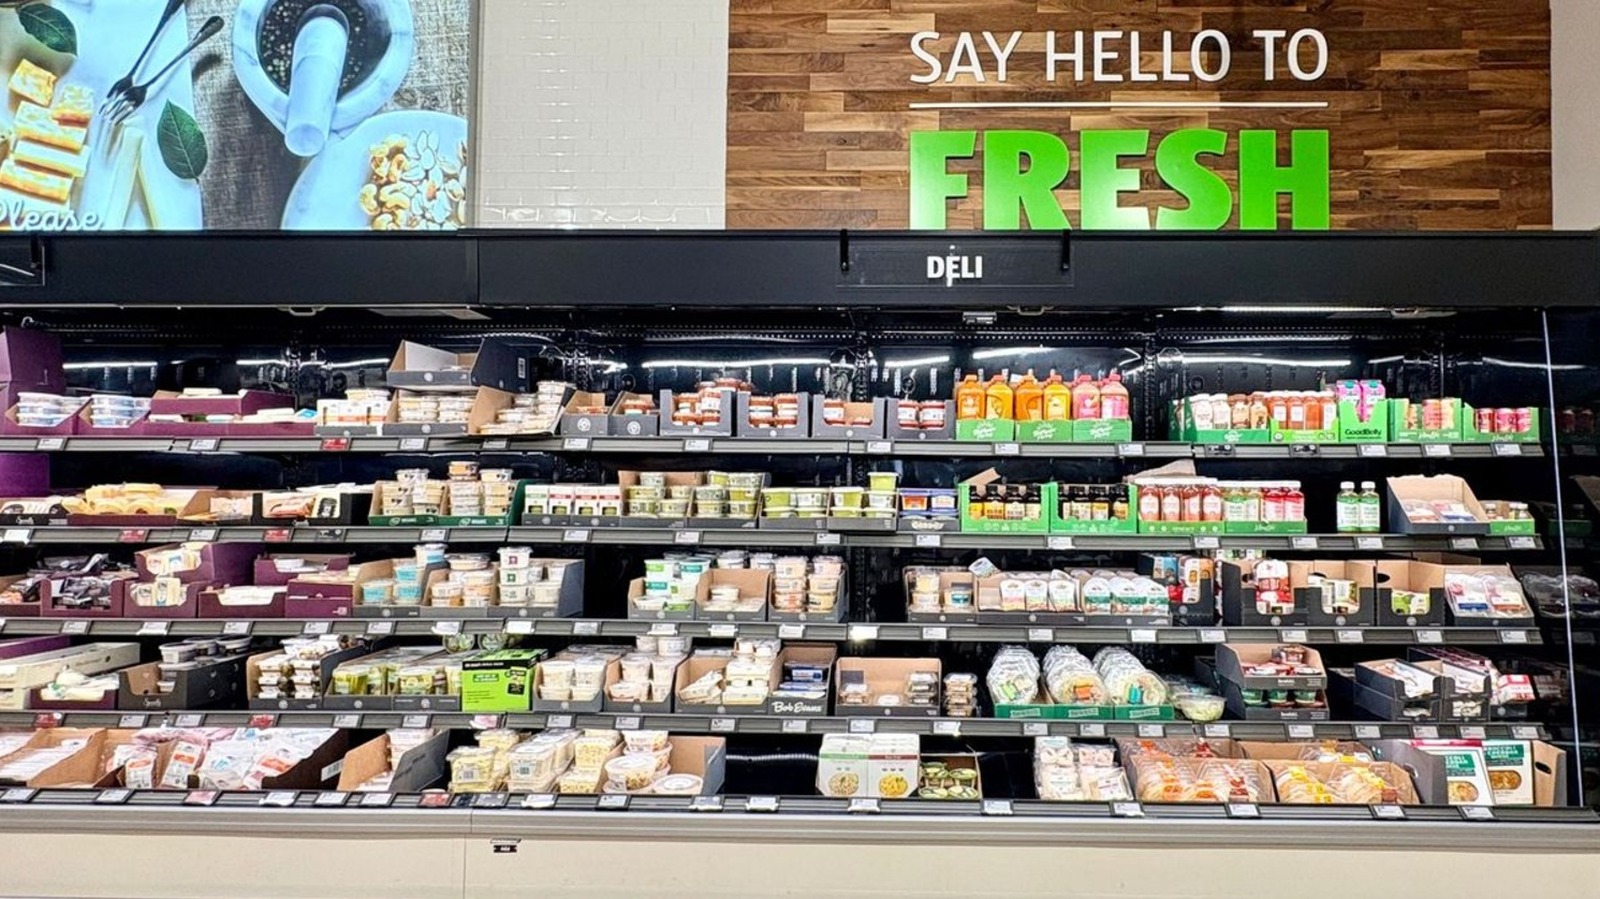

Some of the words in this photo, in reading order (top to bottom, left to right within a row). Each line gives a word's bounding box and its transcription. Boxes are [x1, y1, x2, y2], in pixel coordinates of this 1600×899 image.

[910, 30, 1022, 83] SAY
[1046, 29, 1232, 83] HELLO
[1253, 28, 1330, 82] TO
[909, 128, 1331, 230] FRESH
[926, 255, 983, 279] DELI
[771, 701, 793, 713] Bob
[794, 701, 822, 713] Evans
